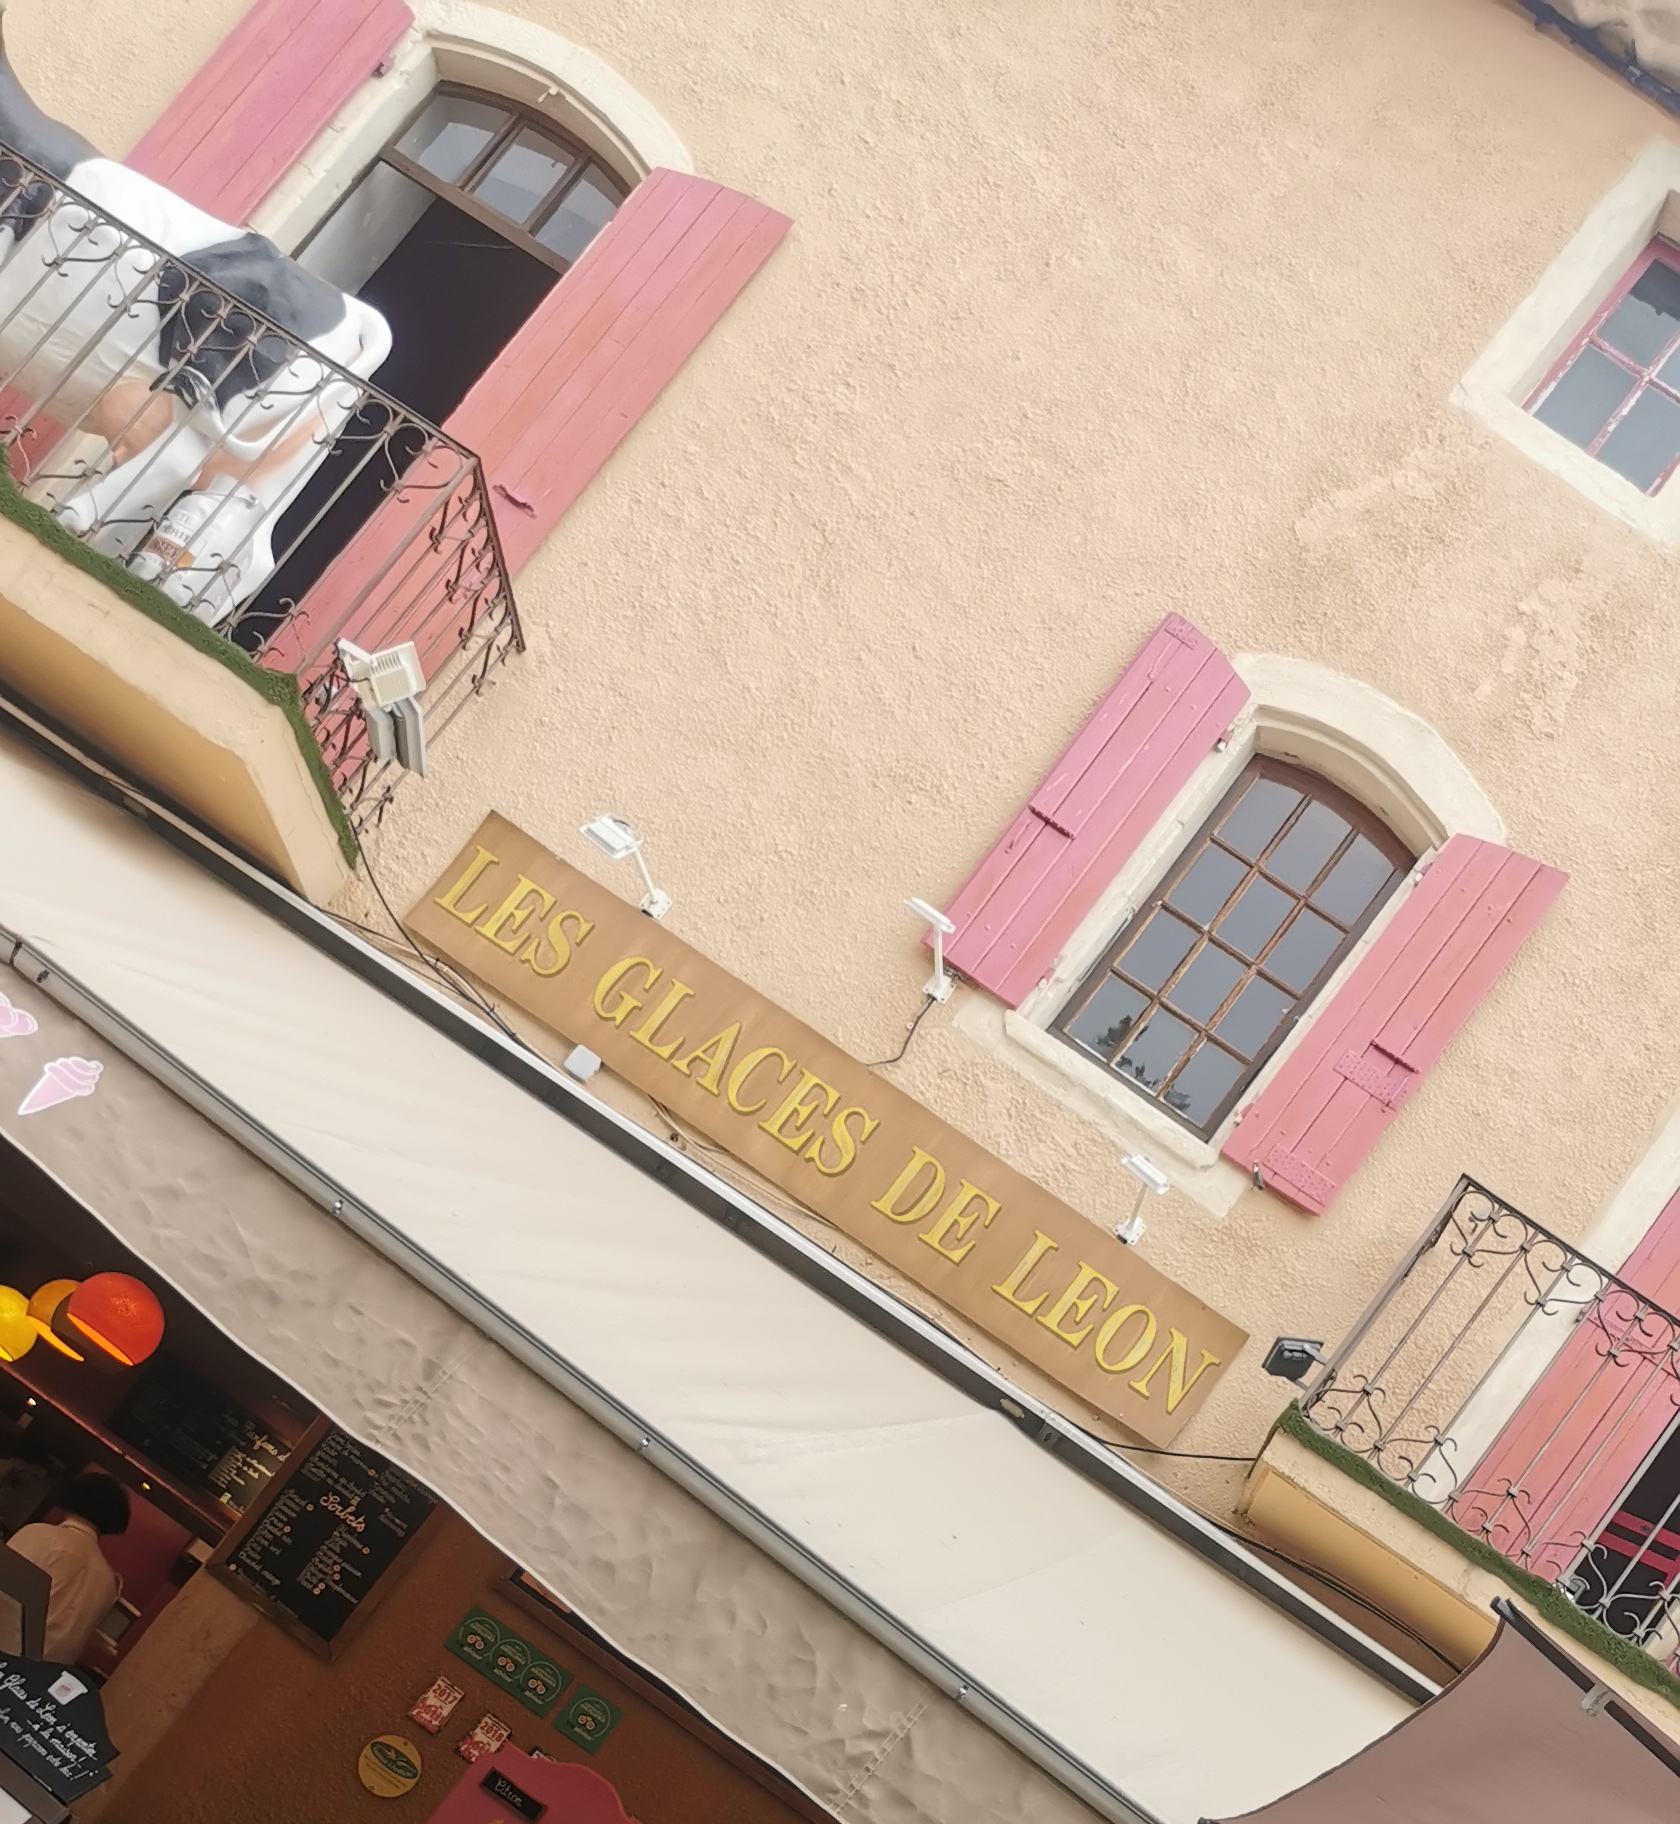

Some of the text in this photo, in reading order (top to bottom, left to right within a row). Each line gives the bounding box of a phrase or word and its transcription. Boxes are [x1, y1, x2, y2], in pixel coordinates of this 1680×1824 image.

[434, 845, 1222, 1415] LES GLACES DE LEON
[320, 1492, 366, 1533] Sorbets
[432, 1684, 458, 1705] 2017
[480, 1721, 504, 1742] 2018
